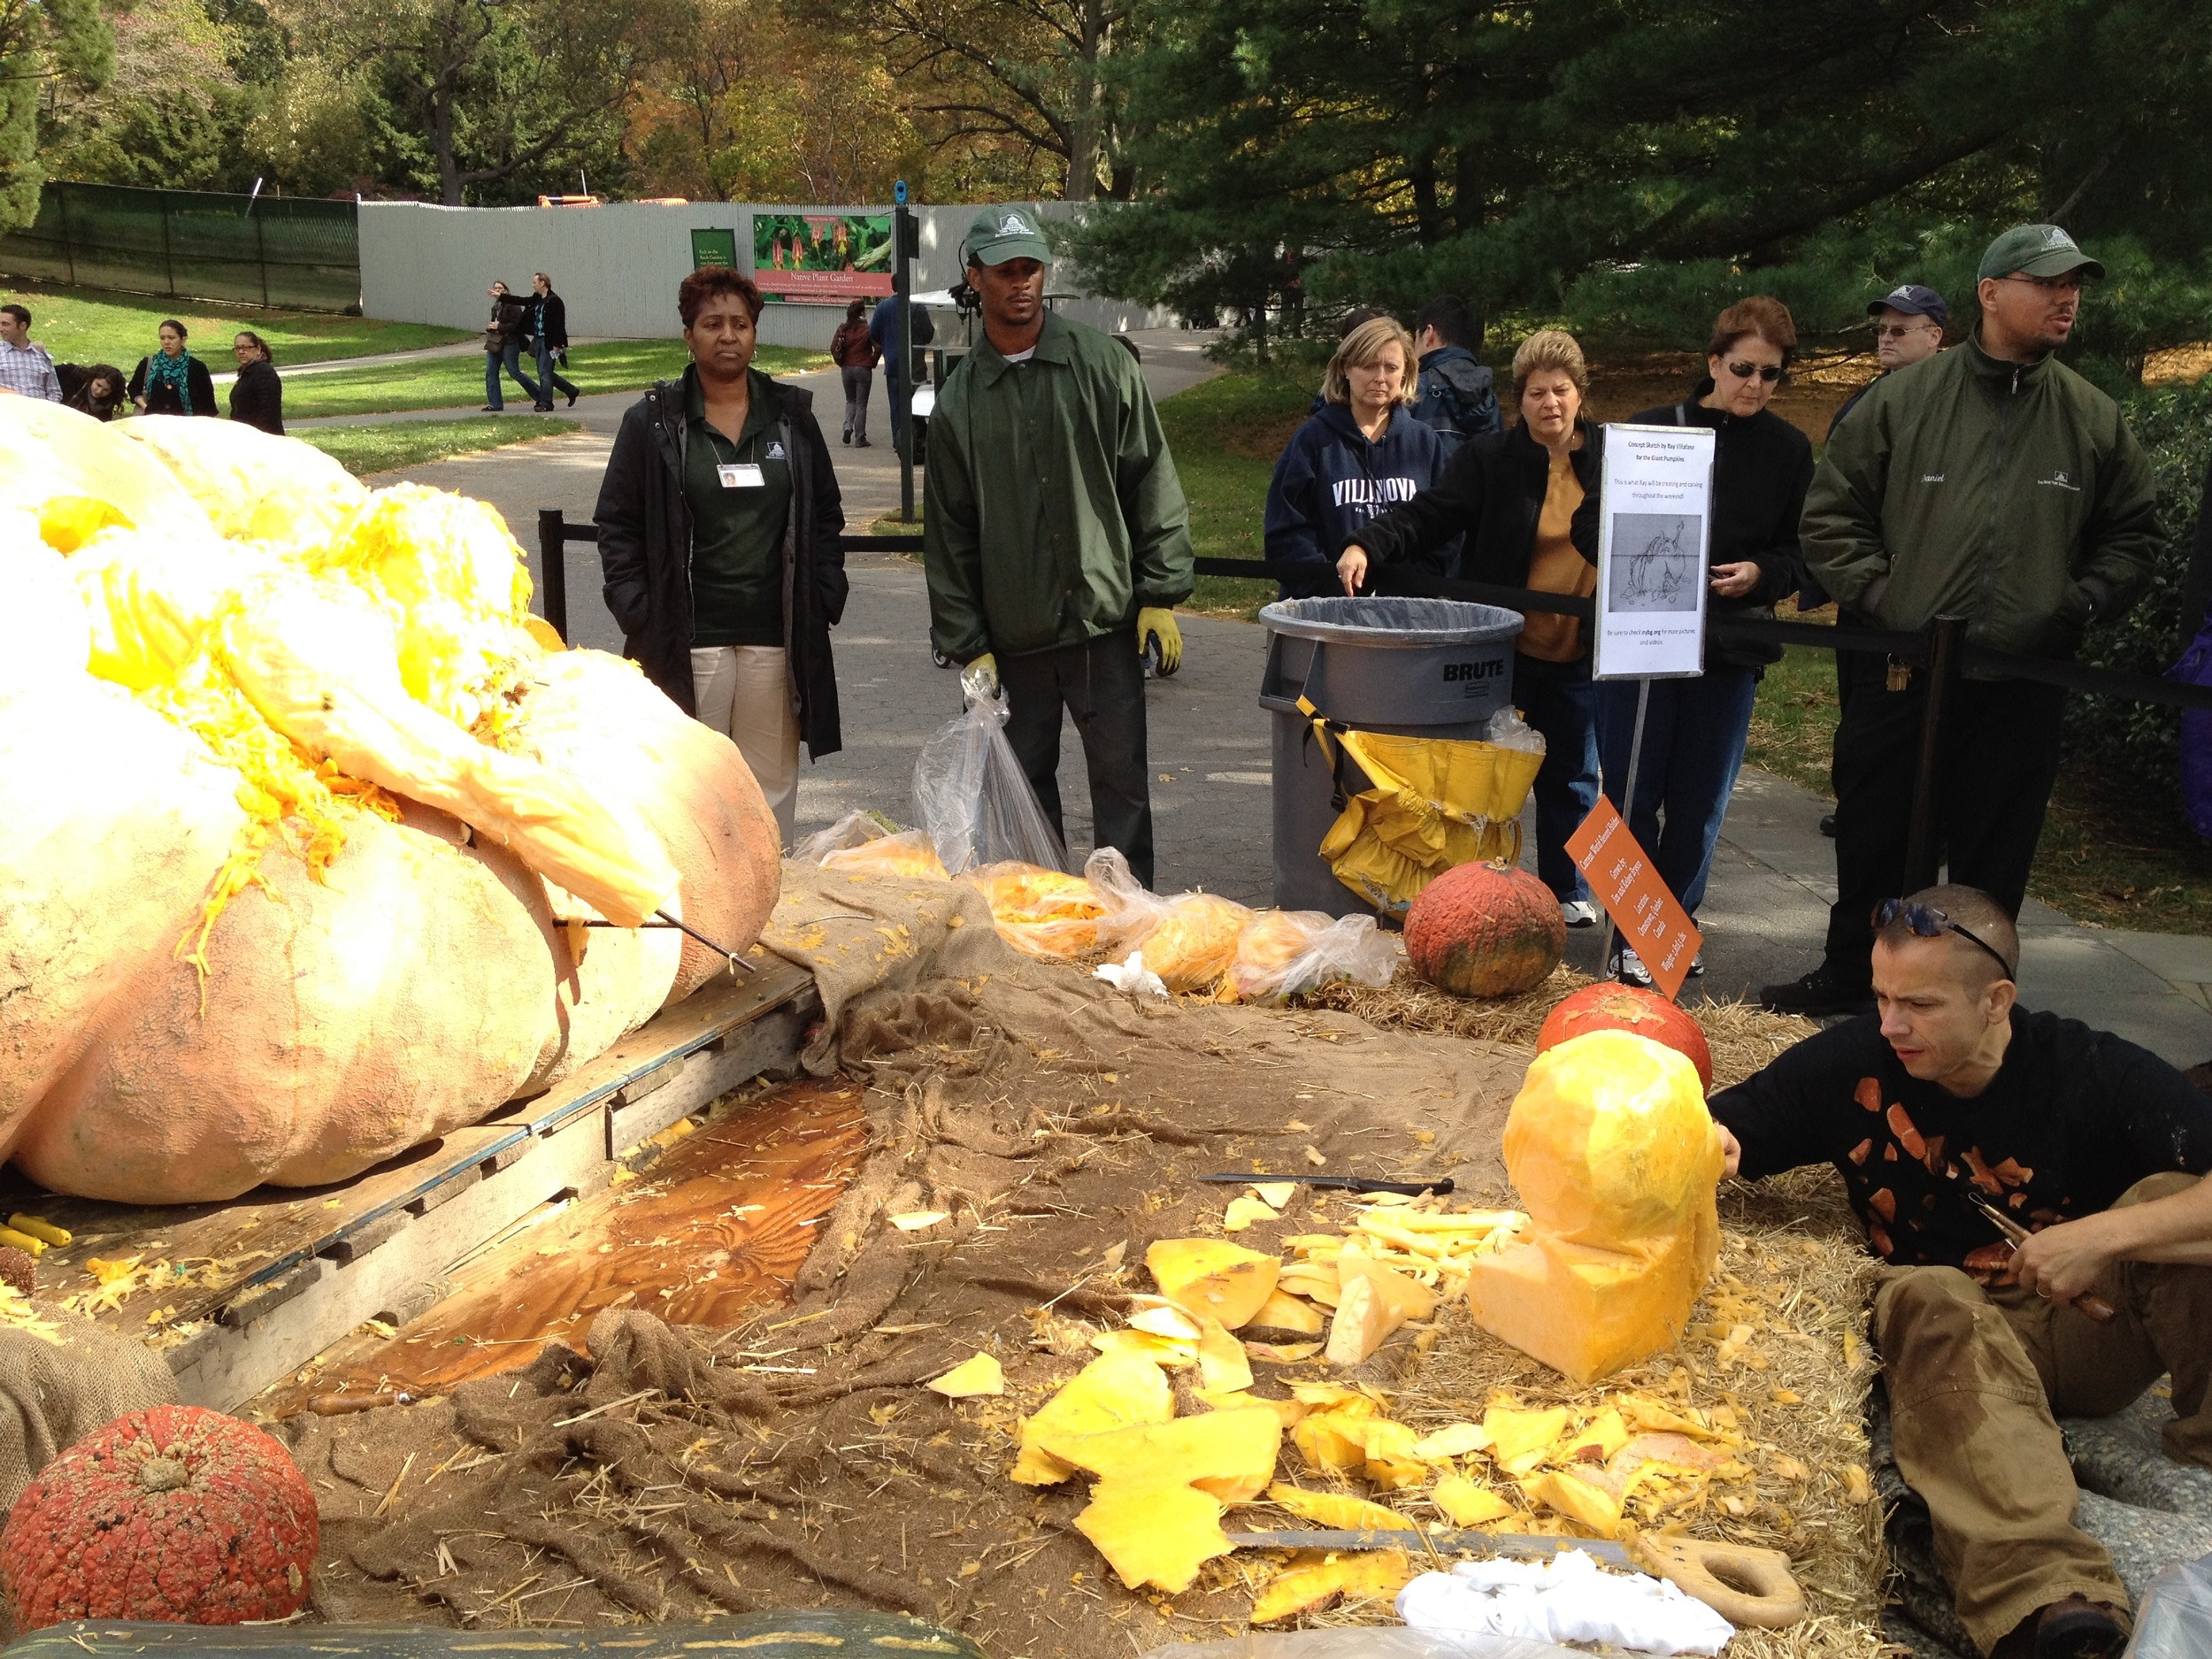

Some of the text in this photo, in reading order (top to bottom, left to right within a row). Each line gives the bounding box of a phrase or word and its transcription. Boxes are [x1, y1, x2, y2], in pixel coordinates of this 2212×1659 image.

[790, 272, 854, 282] Native Plant Garden
[1920, 473, 1945, 483] Daniel
[1443, 658, 1504, 682] BRUTE
[1578, 851, 1595, 871] Current
[1589, 837, 1603, 855] World
[1598, 826, 1612, 845] Record
[1609, 864, 1622, 879] Grown
[1621, 872, 1635, 889] Kelsey
[1617, 883, 1626, 897] and
[1653, 920, 1666, 938] Canada
